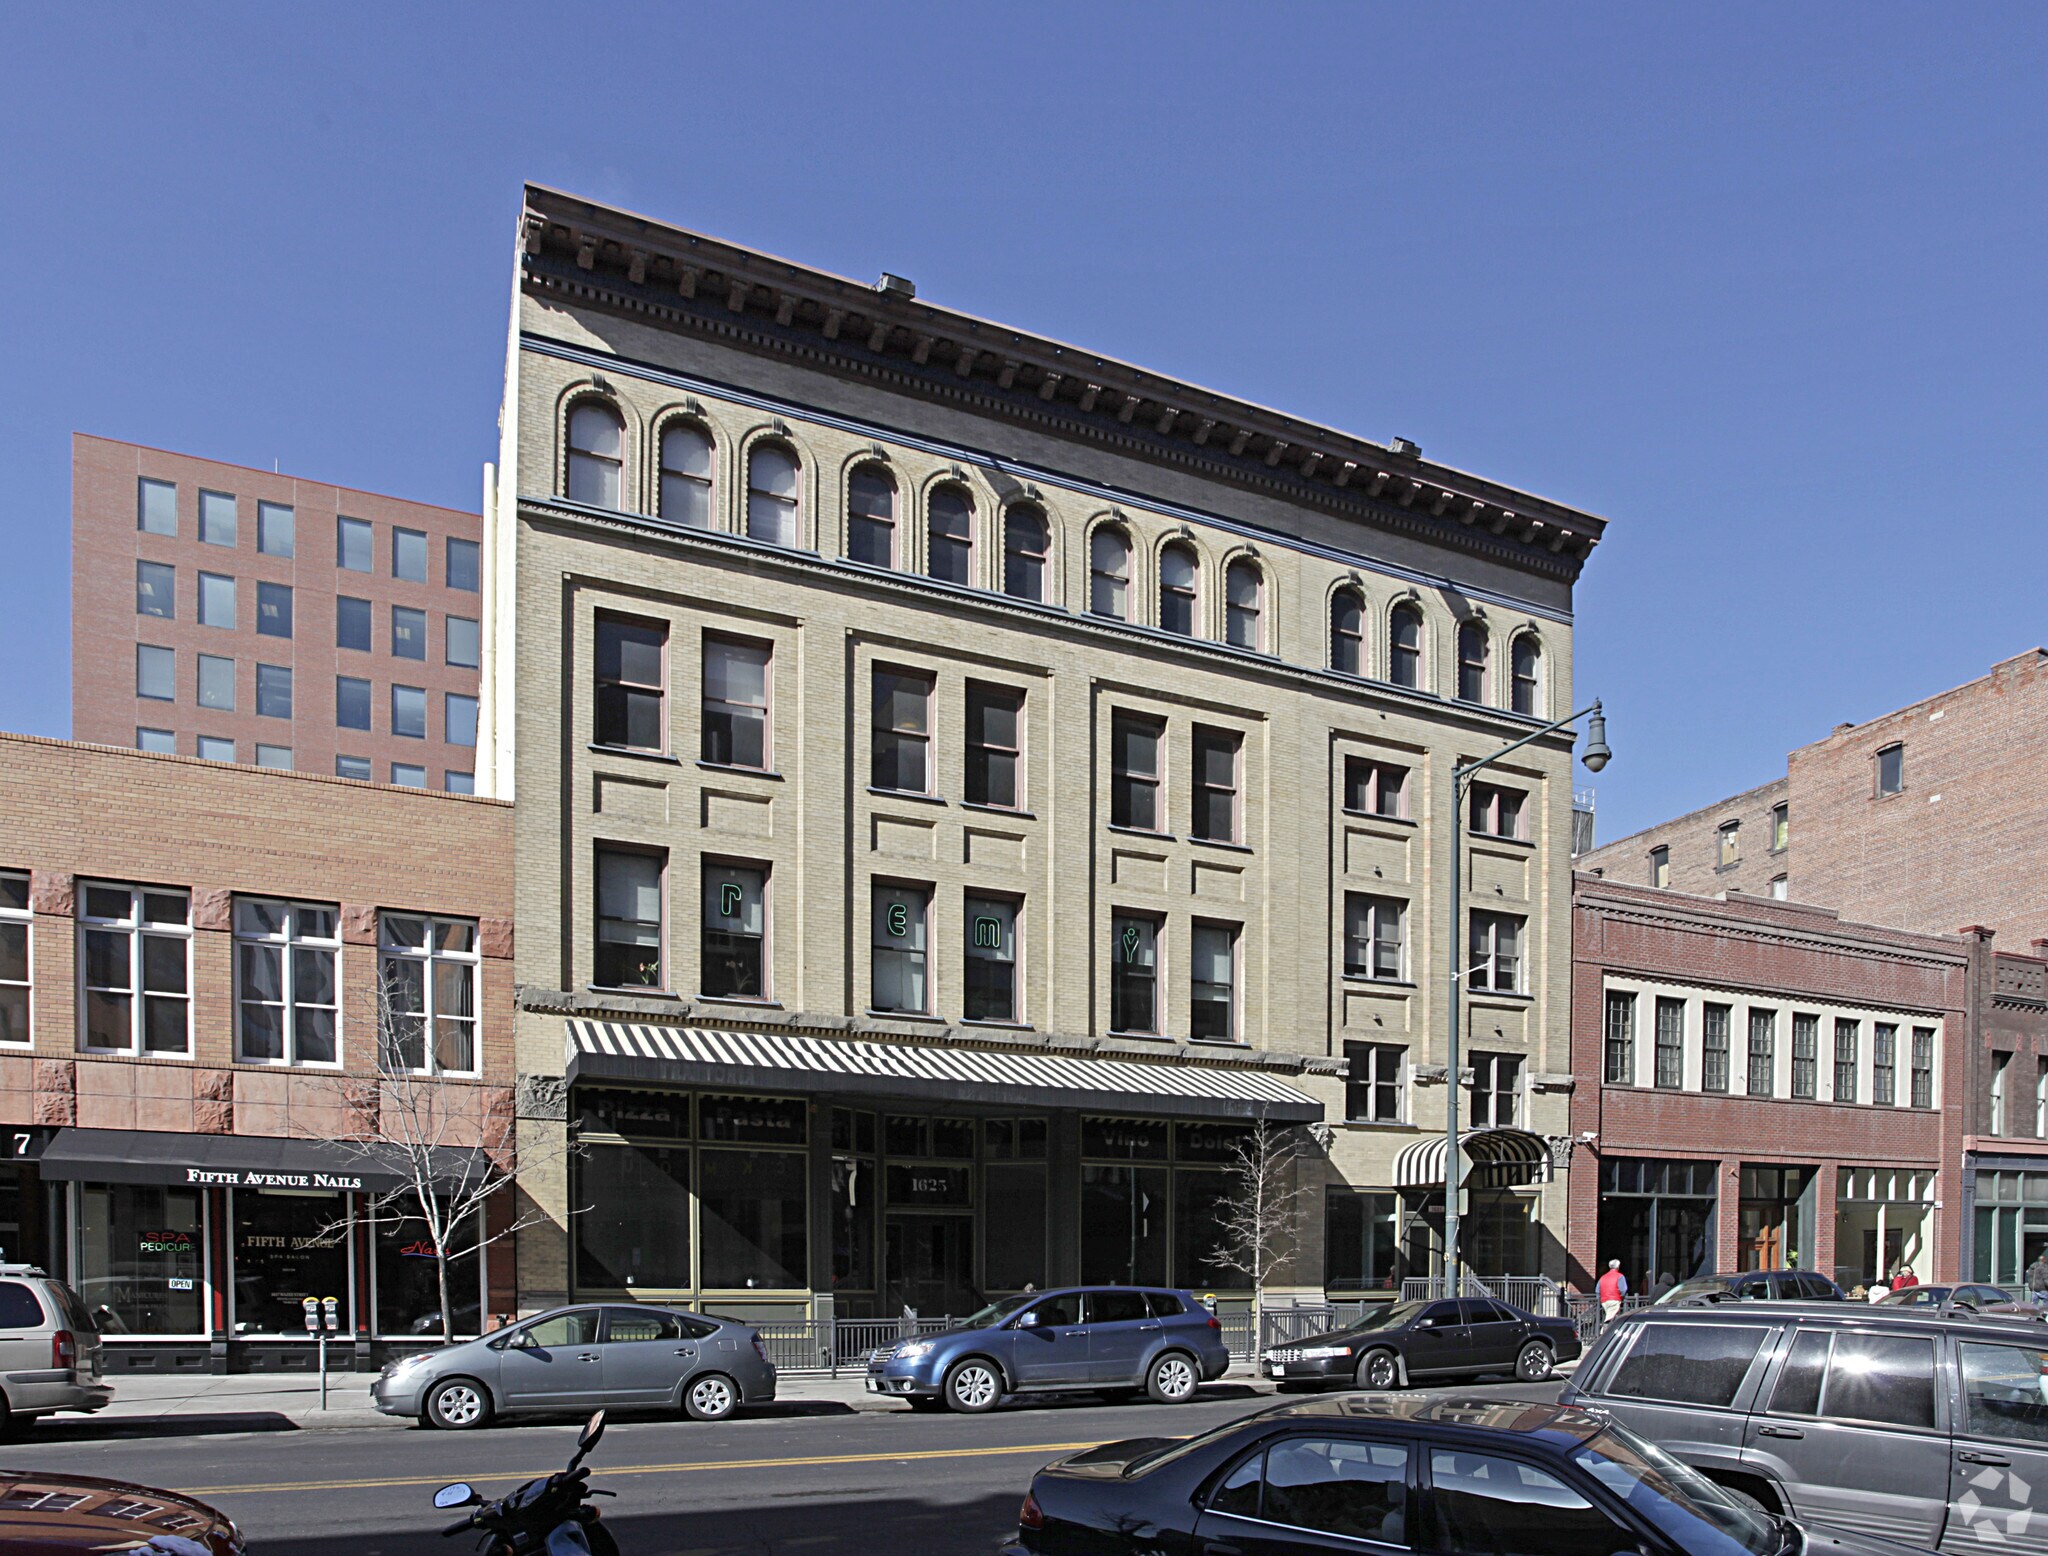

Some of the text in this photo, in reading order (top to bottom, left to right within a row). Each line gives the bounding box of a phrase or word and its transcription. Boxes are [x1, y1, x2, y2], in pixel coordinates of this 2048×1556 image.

[14, 1133, 31, 1154] 7
[1103, 1129, 1150, 1148] Vino
[911, 1177, 947, 1192] 1625
[145, 1232, 191, 1243] SPA
[247, 1236, 285, 1248] FIFTH
[171, 1279, 191, 1288] OPEN
